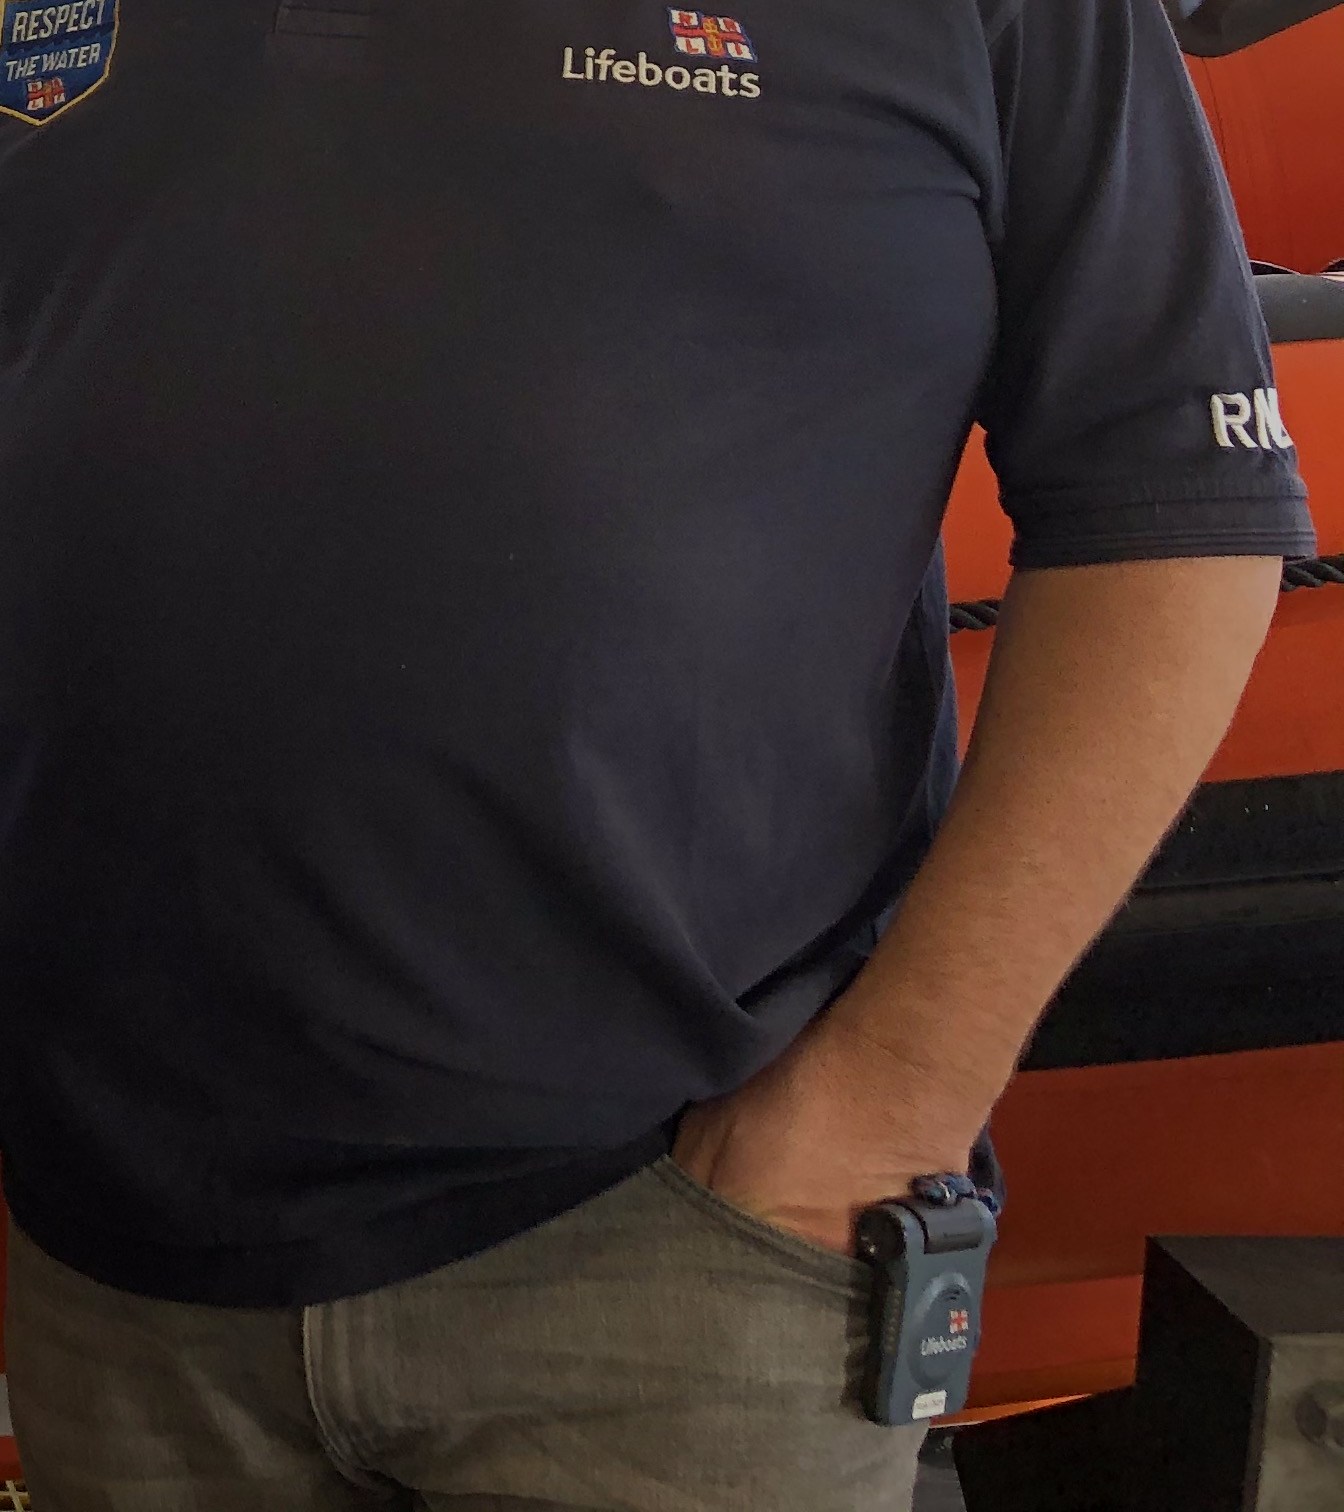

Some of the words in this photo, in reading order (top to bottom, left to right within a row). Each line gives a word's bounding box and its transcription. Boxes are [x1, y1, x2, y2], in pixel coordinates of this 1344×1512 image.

[5, 55, 40, 82] THE
[41, 43, 101, 73] WATER
[562, 46, 761, 98] Lifeboats
